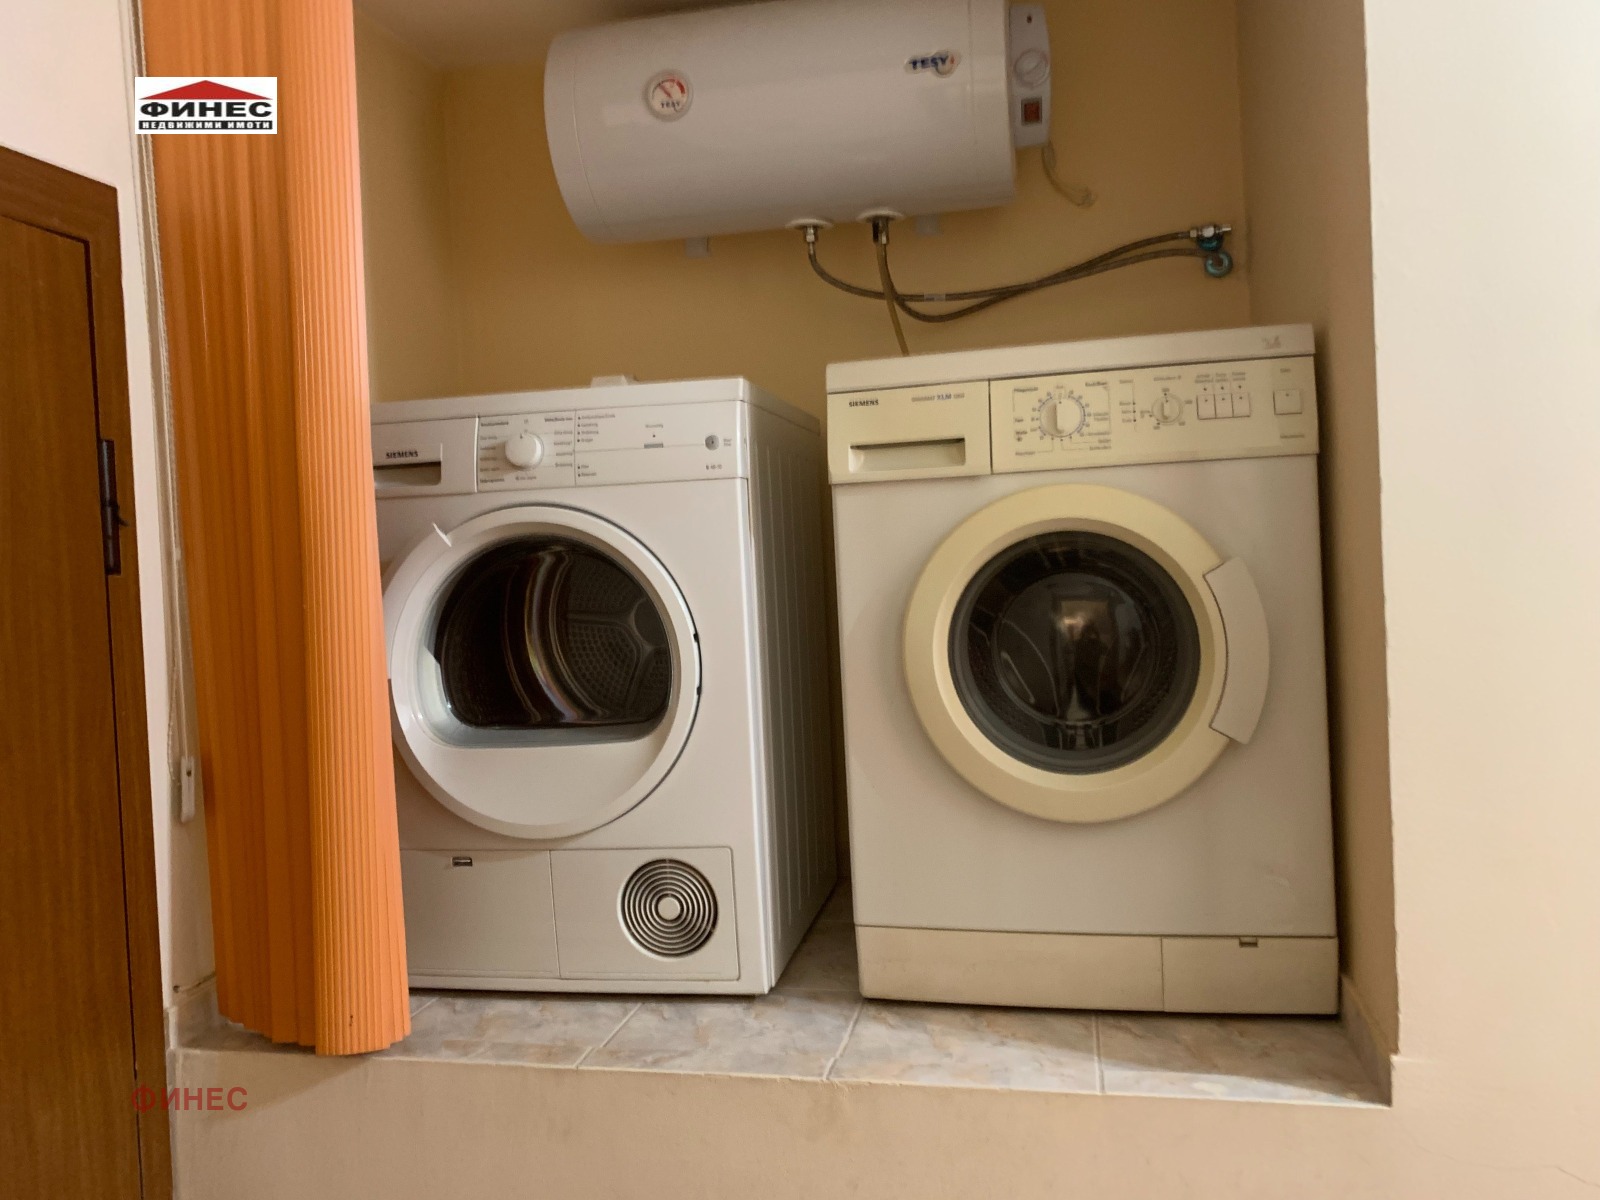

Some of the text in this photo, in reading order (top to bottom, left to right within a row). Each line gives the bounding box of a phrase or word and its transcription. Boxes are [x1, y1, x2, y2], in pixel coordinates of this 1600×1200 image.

[908, 54, 949, 72] TESY
[848, 399, 880, 408] SIEMENS
[385, 450, 419, 459] SIEMENS
